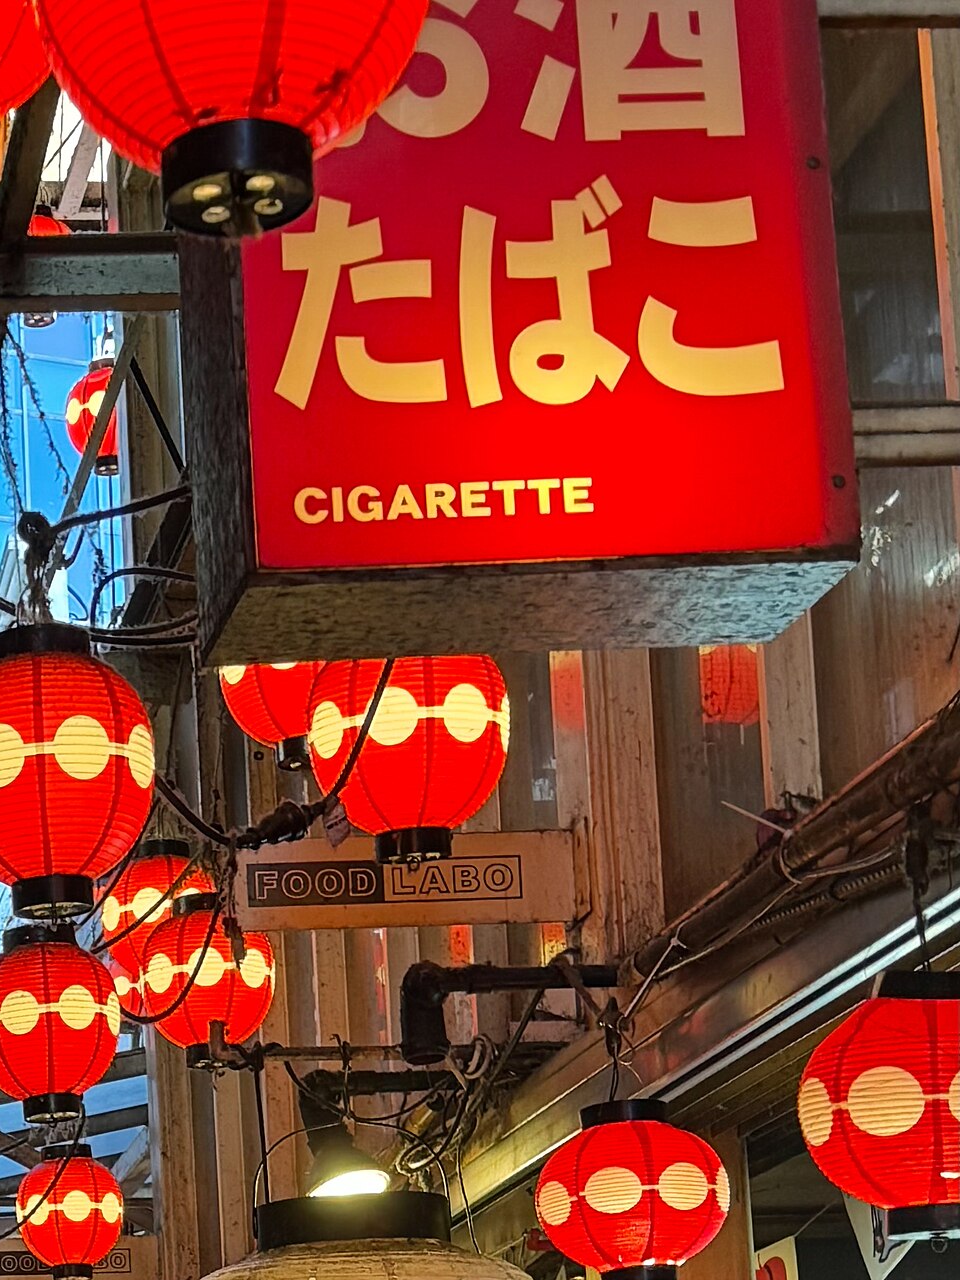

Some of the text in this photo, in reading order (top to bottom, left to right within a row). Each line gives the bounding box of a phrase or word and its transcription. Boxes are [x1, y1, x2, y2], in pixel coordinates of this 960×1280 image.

[274, 174, 785, 411] たばこ
[293, 477, 595, 524] CIGARETTE
[254, 862, 515, 900] FOOD LABO
